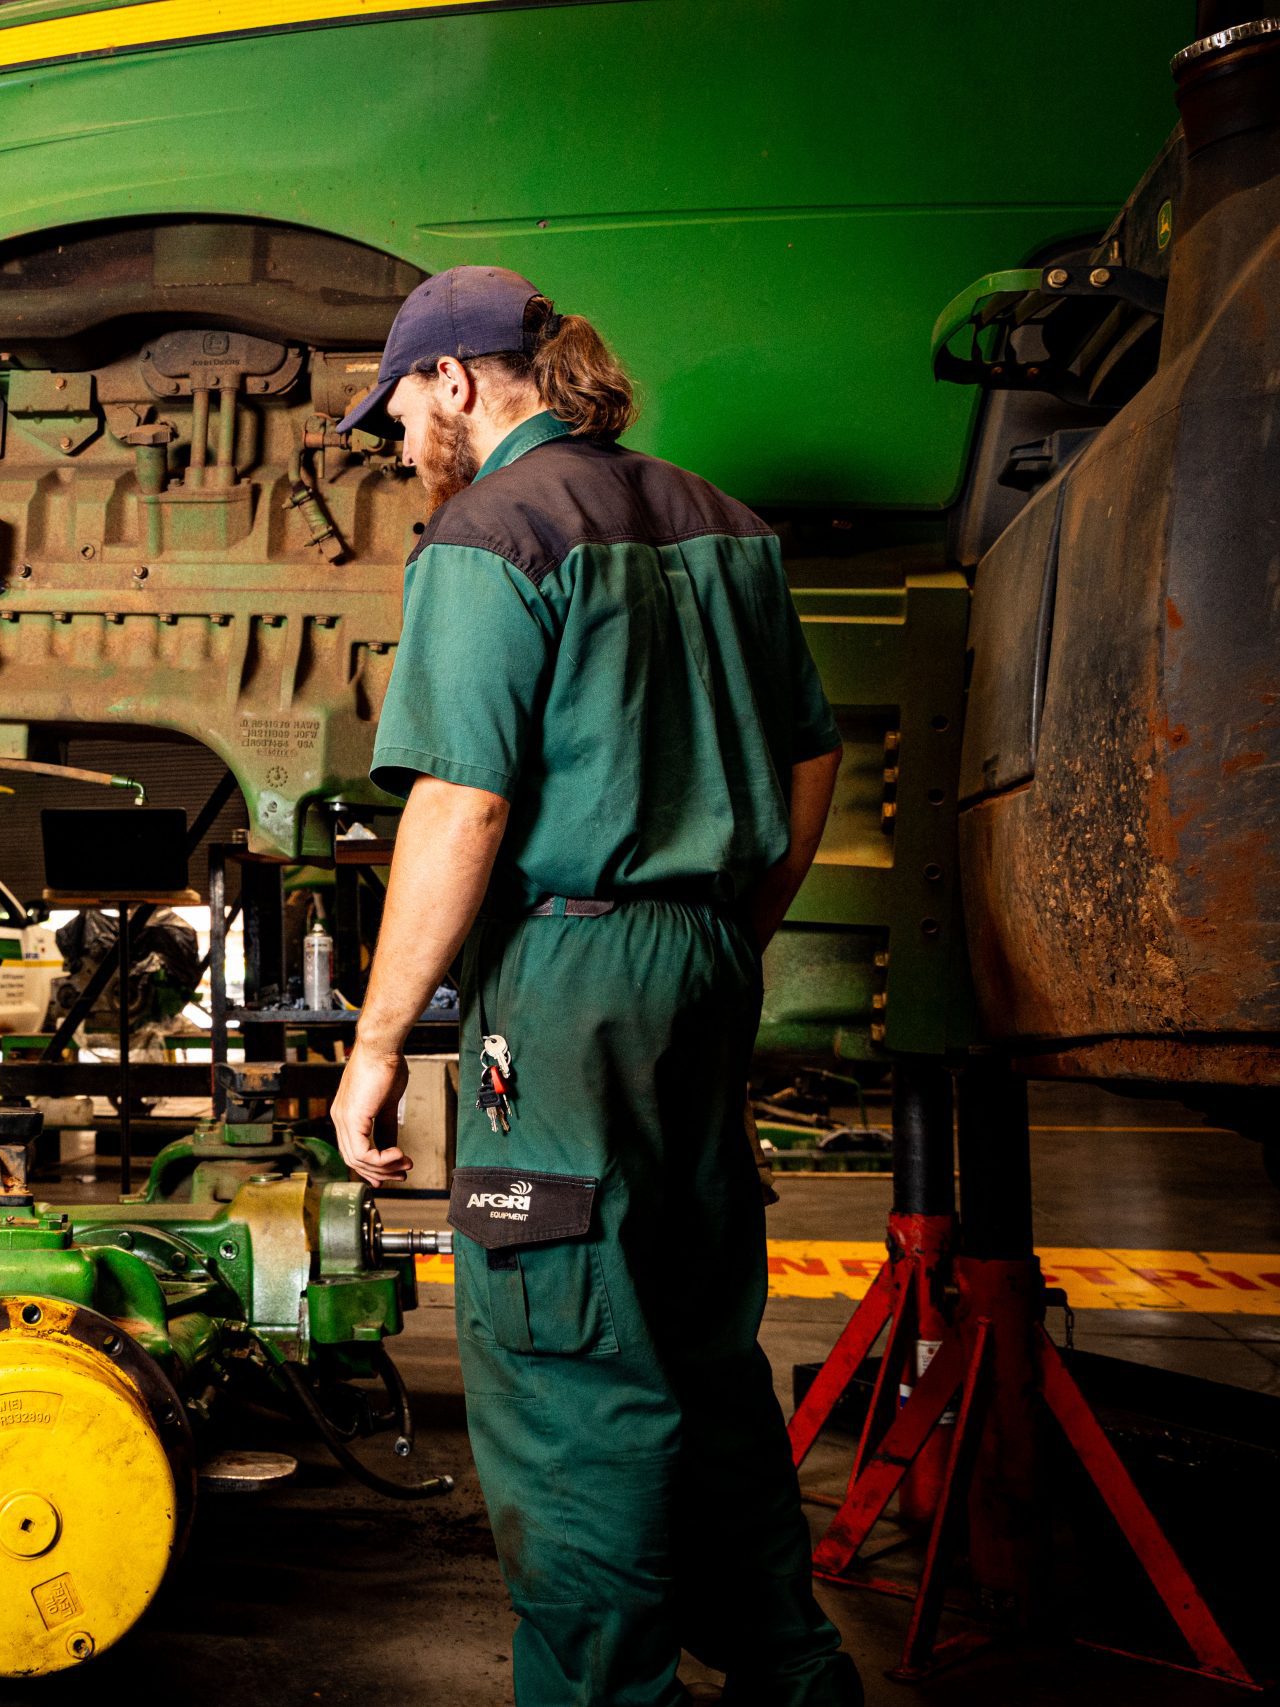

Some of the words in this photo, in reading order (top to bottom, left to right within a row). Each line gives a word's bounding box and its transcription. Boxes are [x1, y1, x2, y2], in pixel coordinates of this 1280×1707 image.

[466, 1193, 531, 1210] AFGRI
[489, 1211, 528, 1221] EQUIPMENT
[45, 1595, 59, 1615] OIL
[57, 1582, 73, 1618] LEVEL
